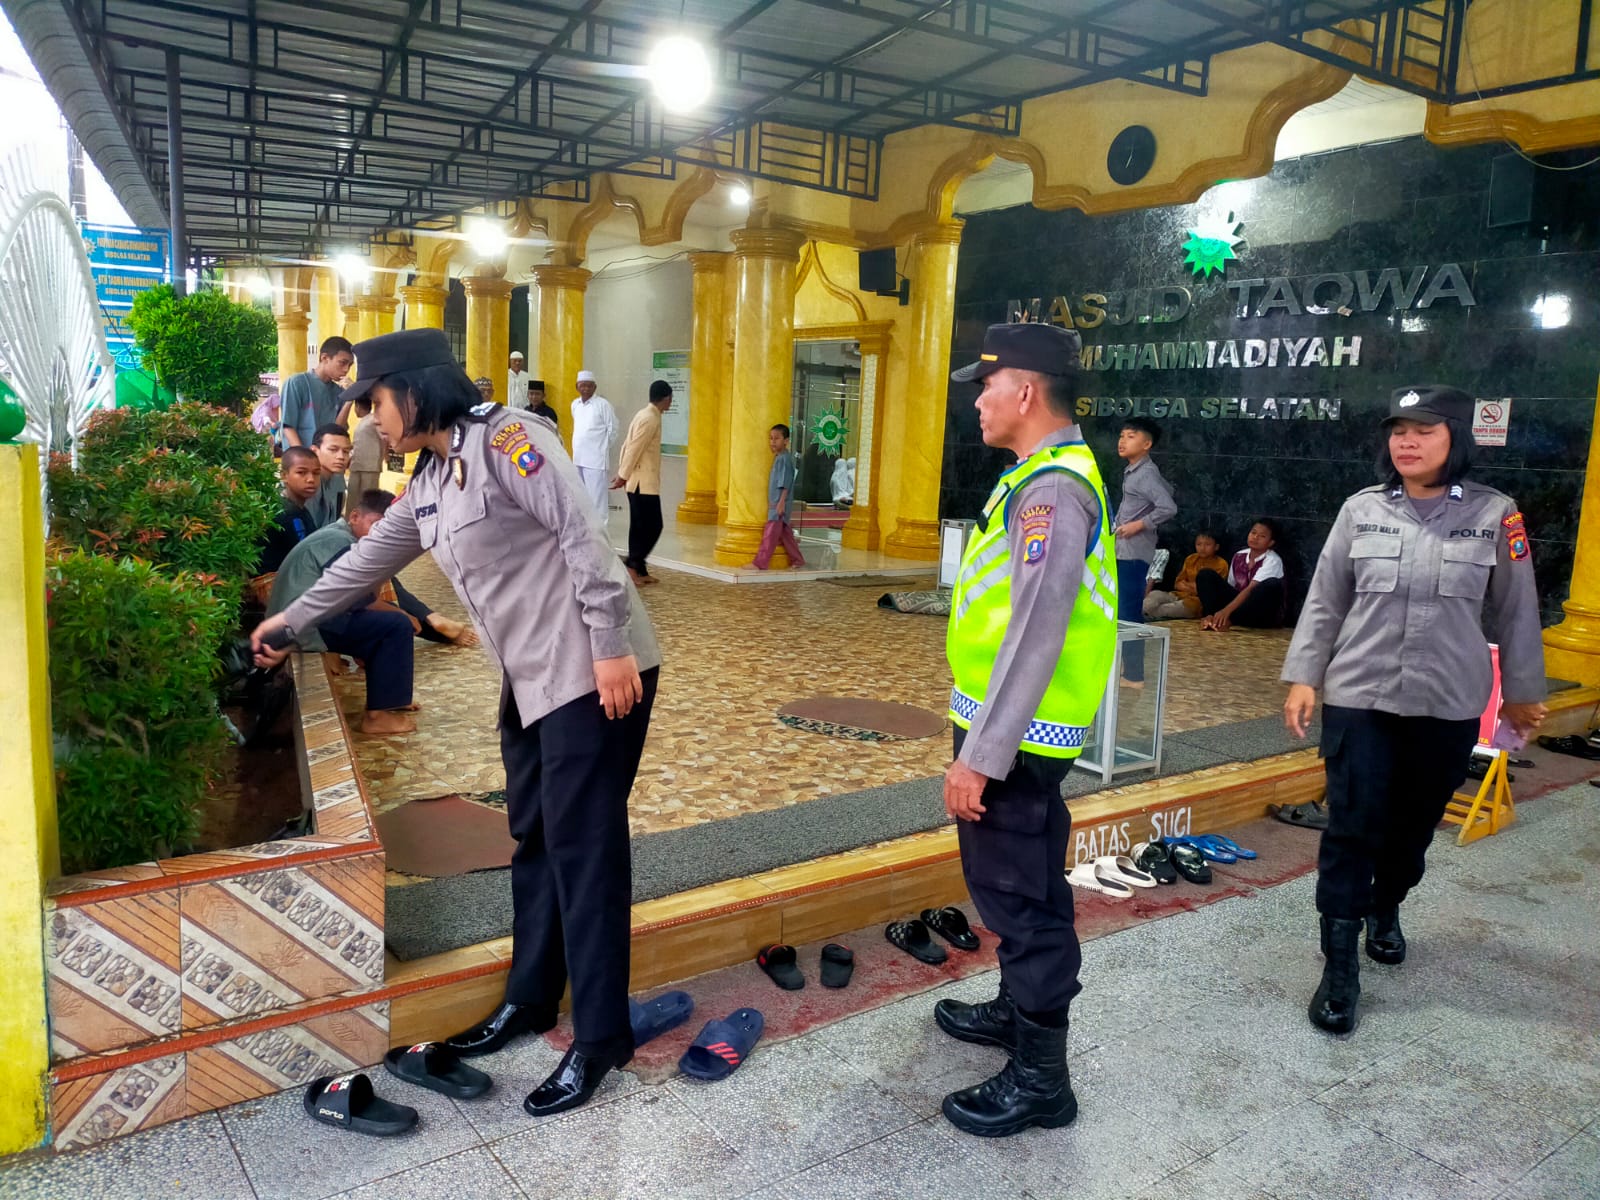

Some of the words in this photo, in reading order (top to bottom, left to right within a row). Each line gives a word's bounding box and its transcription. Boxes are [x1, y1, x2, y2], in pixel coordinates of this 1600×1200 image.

[1007, 285, 1192, 330] MASJID
[1226, 262, 1477, 319] TAQWA
[1079, 336, 1363, 371] MUHAMMADIYAH
[1075, 397, 1189, 418] SIBOLGA
[1200, 397, 1342, 421] SELATAN
[1449, 528, 1495, 540] POLRI
[1075, 822, 1131, 865] BATAS
[1150, 806, 1192, 843] SUCI
[319, 1108, 345, 1120] porto
